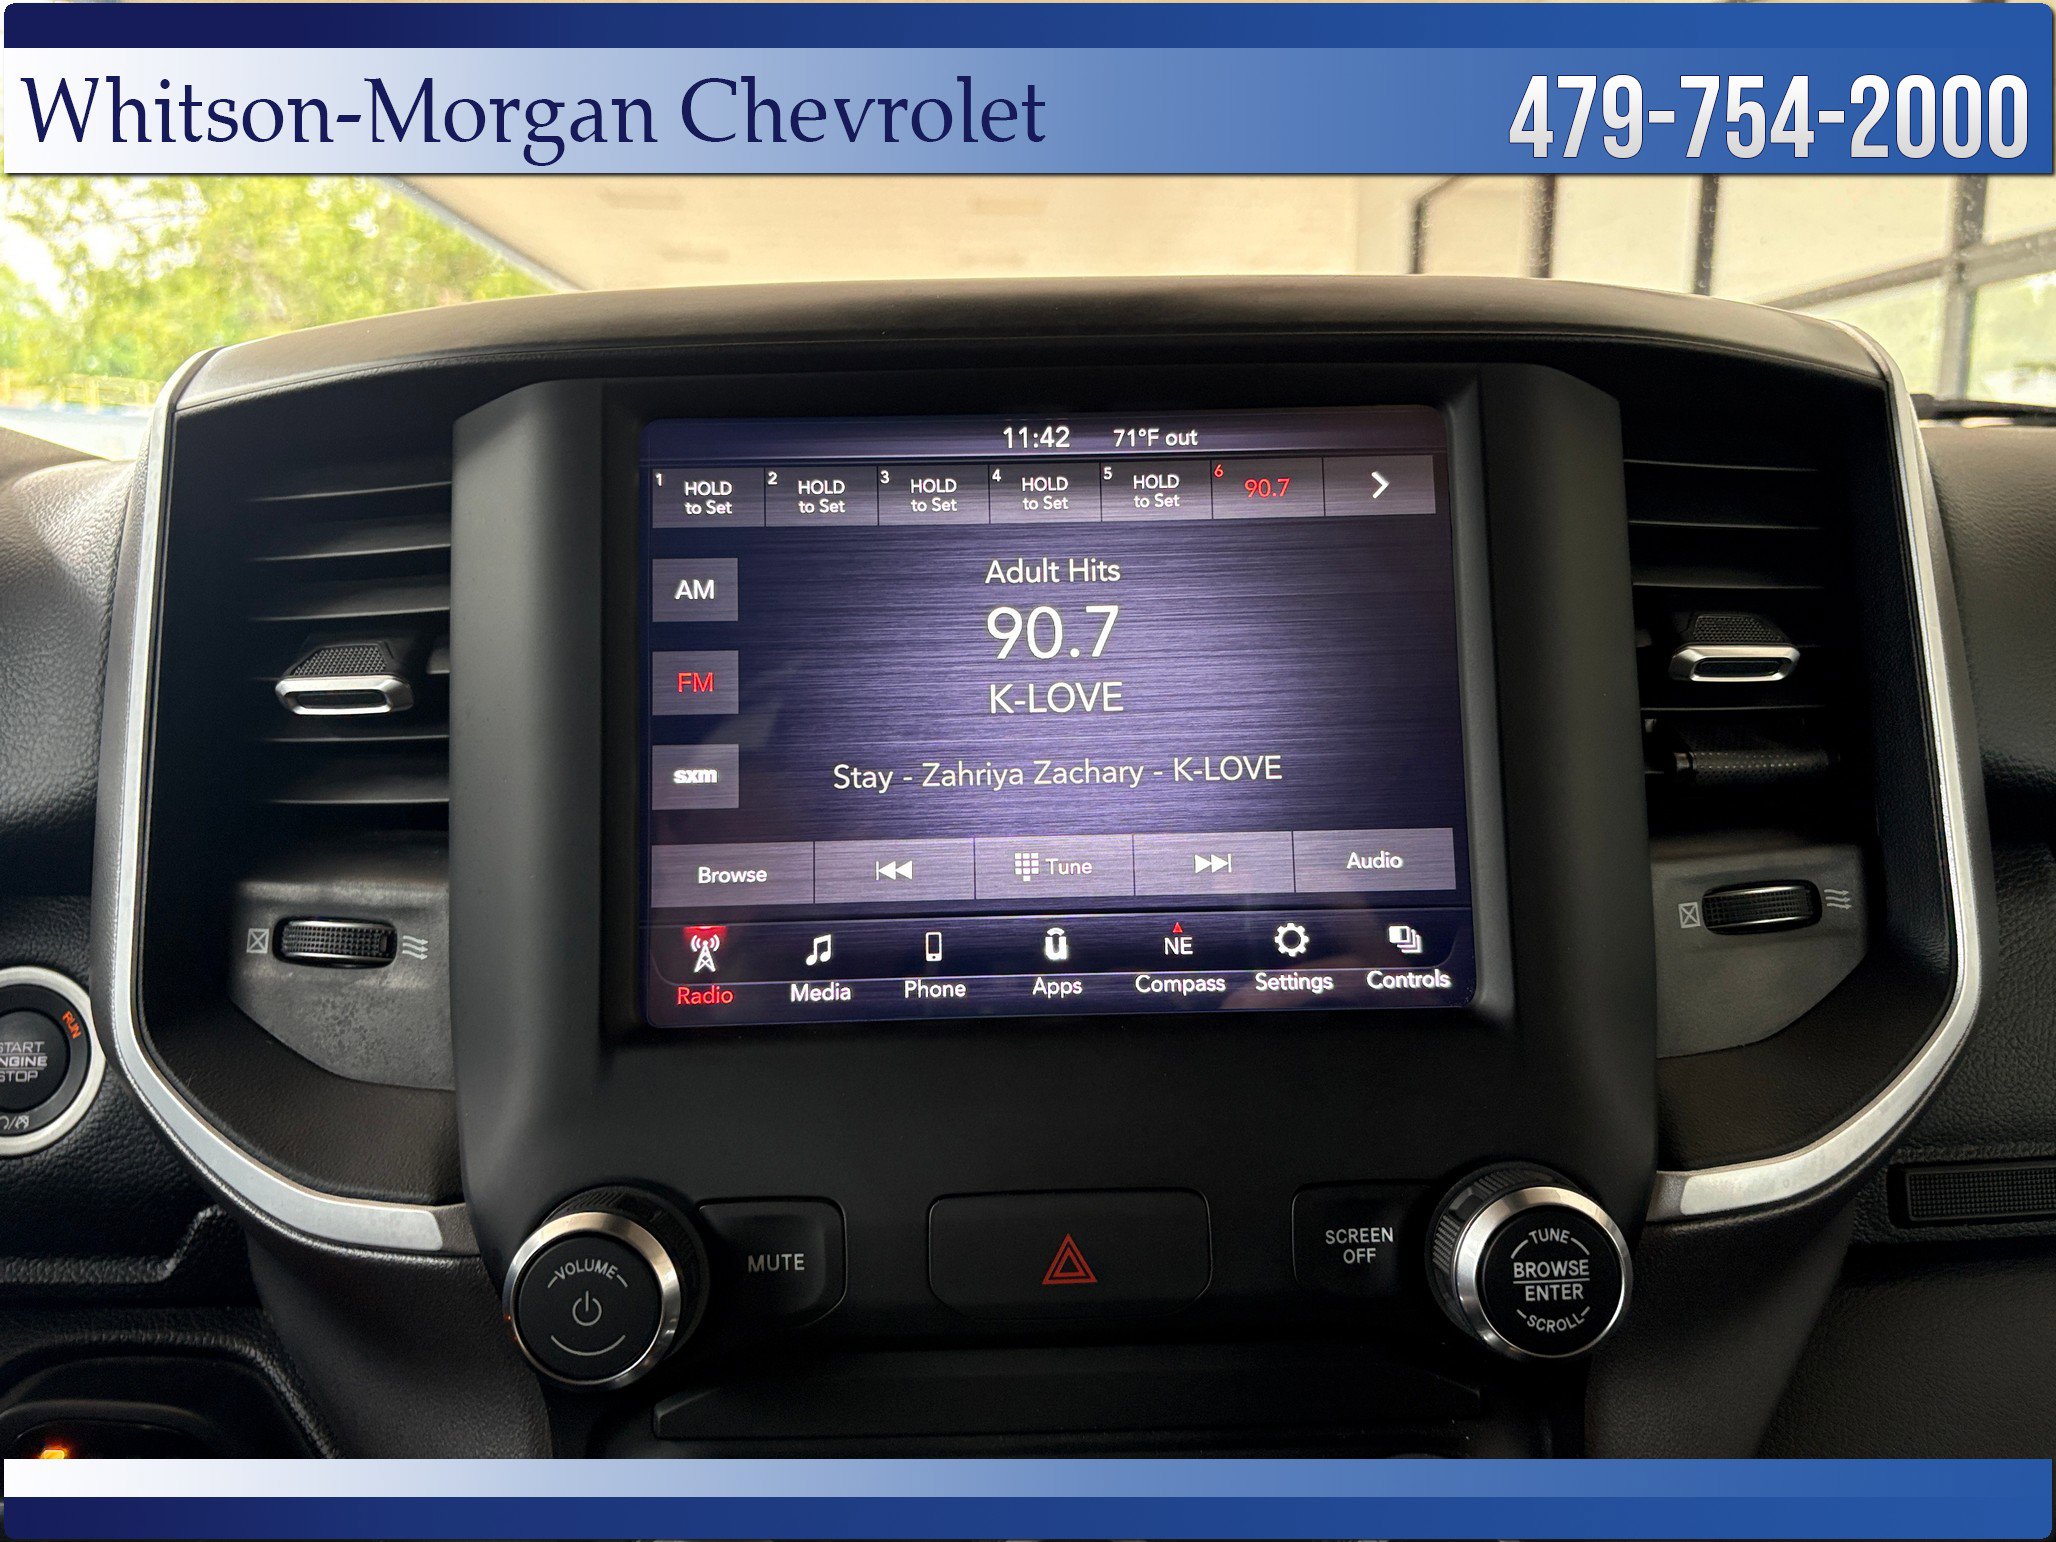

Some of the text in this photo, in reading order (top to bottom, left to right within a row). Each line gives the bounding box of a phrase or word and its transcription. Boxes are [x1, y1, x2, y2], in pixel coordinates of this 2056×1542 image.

[1003, 426, 1071, 449] 11:42
[1113, 428, 1199, 447] 71°F out
[655, 472, 662, 487] 1
[767, 471, 778, 485] 2
[880, 469, 890, 484] 3
[991, 468, 1002, 482] 4
[1103, 466, 1113, 480] 5
[1213, 464, 1225, 479] 6
[684, 480, 733, 496] HOLD
[798, 479, 846, 495] HOLD
[910, 478, 957, 494] HOLD
[1021, 476, 1069, 492] HOLD
[1133, 474, 1180, 490] HOLD
[1244, 477, 1291, 499] 90.7
[684, 499, 733, 515] to Set
[798, 498, 846, 514] to Set
[910, 497, 958, 512] to Set
[1022, 495, 1070, 511] to Set
[1133, 492, 1180, 508] to Set
[984, 557, 1121, 584] Adult Hits
[674, 579, 715, 600] AM
[987, 605, 1119, 660] 90.7
[677, 672, 714, 692] FM
[989, 681, 1124, 714] K-LOVE
[673, 769, 718, 784] sxm
[833, 763, 894, 794] Stay
[922, 760, 1024, 792] Zahriya
[1033, 757, 1144, 789] Zachary
[1173, 755, 1283, 782] K-LOVE
[1045, 857, 1093, 875] Tune
[1346, 850, 1404, 870] Audio
[698, 866, 768, 884] Browse
[1164, 936, 1194, 955] NE
[904, 979, 967, 998] Phone
[1032, 976, 1083, 999] Apps
[1135, 974, 1226, 995] Compass
[1255, 971, 1334, 994] Settings
[1366, 968, 1452, 990] Controls
[678, 986, 734, 1005] Radio
[790, 981, 851, 1002] Media
[62, 1011, 81, 1039] RUN
[0, 1056, 48, 1067] NGINE
[1325, 1226, 1394, 1245] SCREEN
[1528, 1227, 1570, 1244] TUNE
[748, 1253, 805, 1272] MUTE
[1343, 1247, 1377, 1264] OFF
[555, 1259, 618, 1281] VOLUME
[1513, 1259, 1590, 1279] BROWSE
[1525, 1283, 1584, 1302] ENTER
[1527, 1312, 1584, 1333] SCROLL
